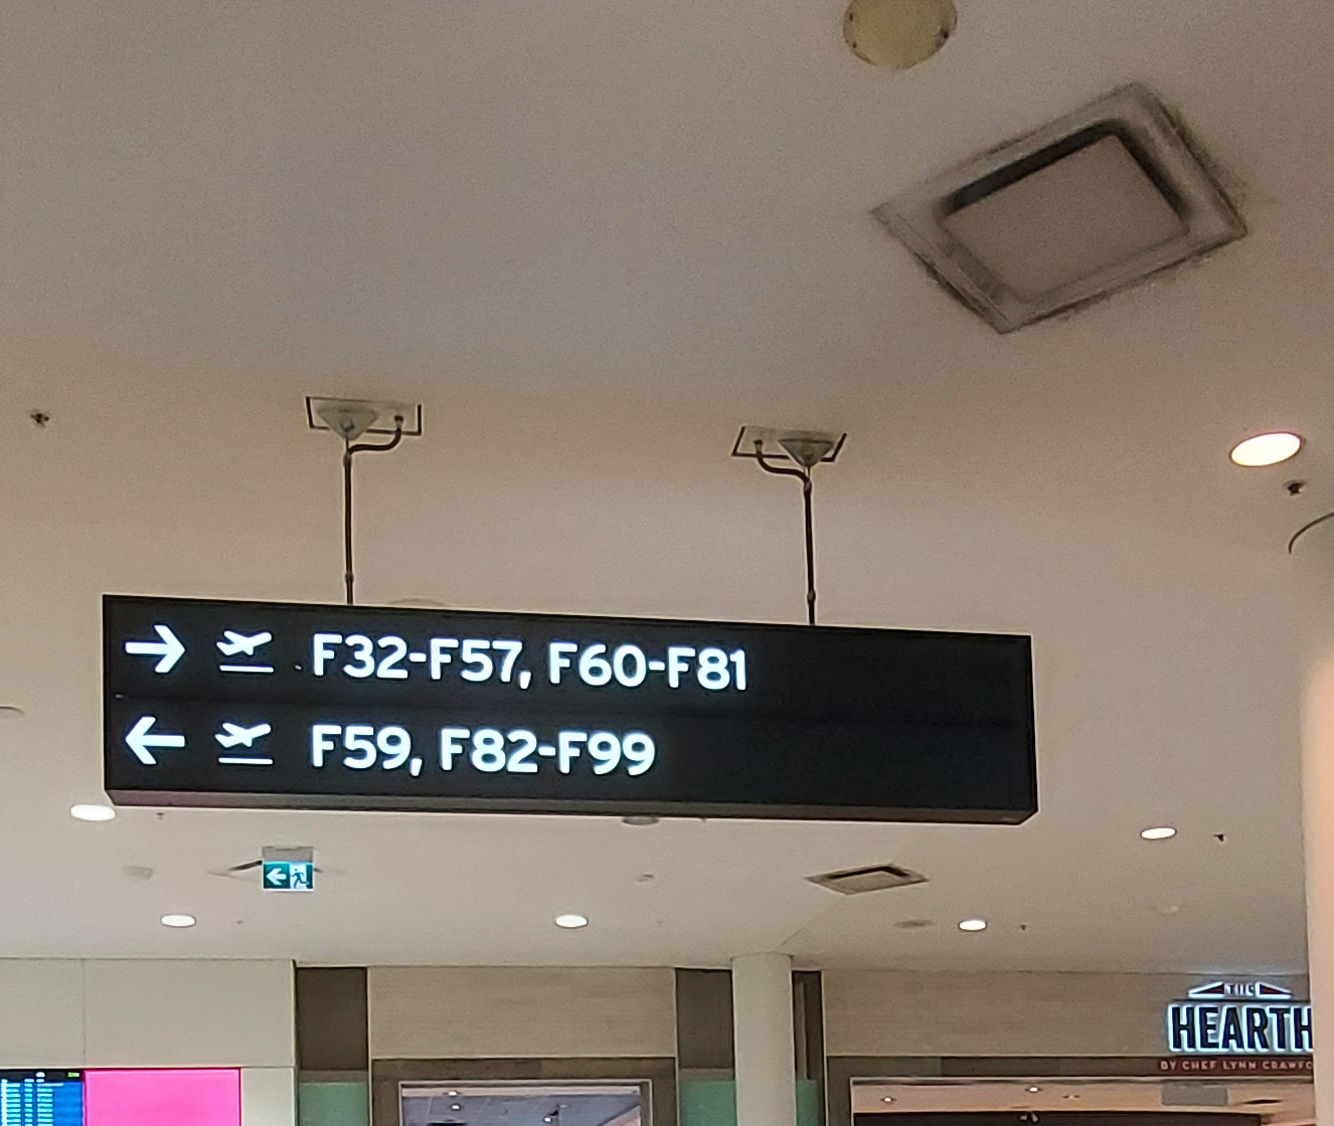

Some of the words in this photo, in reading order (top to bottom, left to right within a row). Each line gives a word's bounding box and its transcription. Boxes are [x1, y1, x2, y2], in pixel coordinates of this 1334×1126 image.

[313, 633, 532, 690] F32-F57,
[548, 641, 747, 691] F60-F81
[311, 724, 423, 777] F59,
[440, 727, 656, 776] F82-F99
[1229, 983, 1256, 996] THE
[1169, 1004, 1314, 1051] HEARTH
[1160, 1060, 1178, 1071] BY
[1181, 1060, 1218, 1071] CHEF
[1222, 1060, 1257, 1070] LYNN
